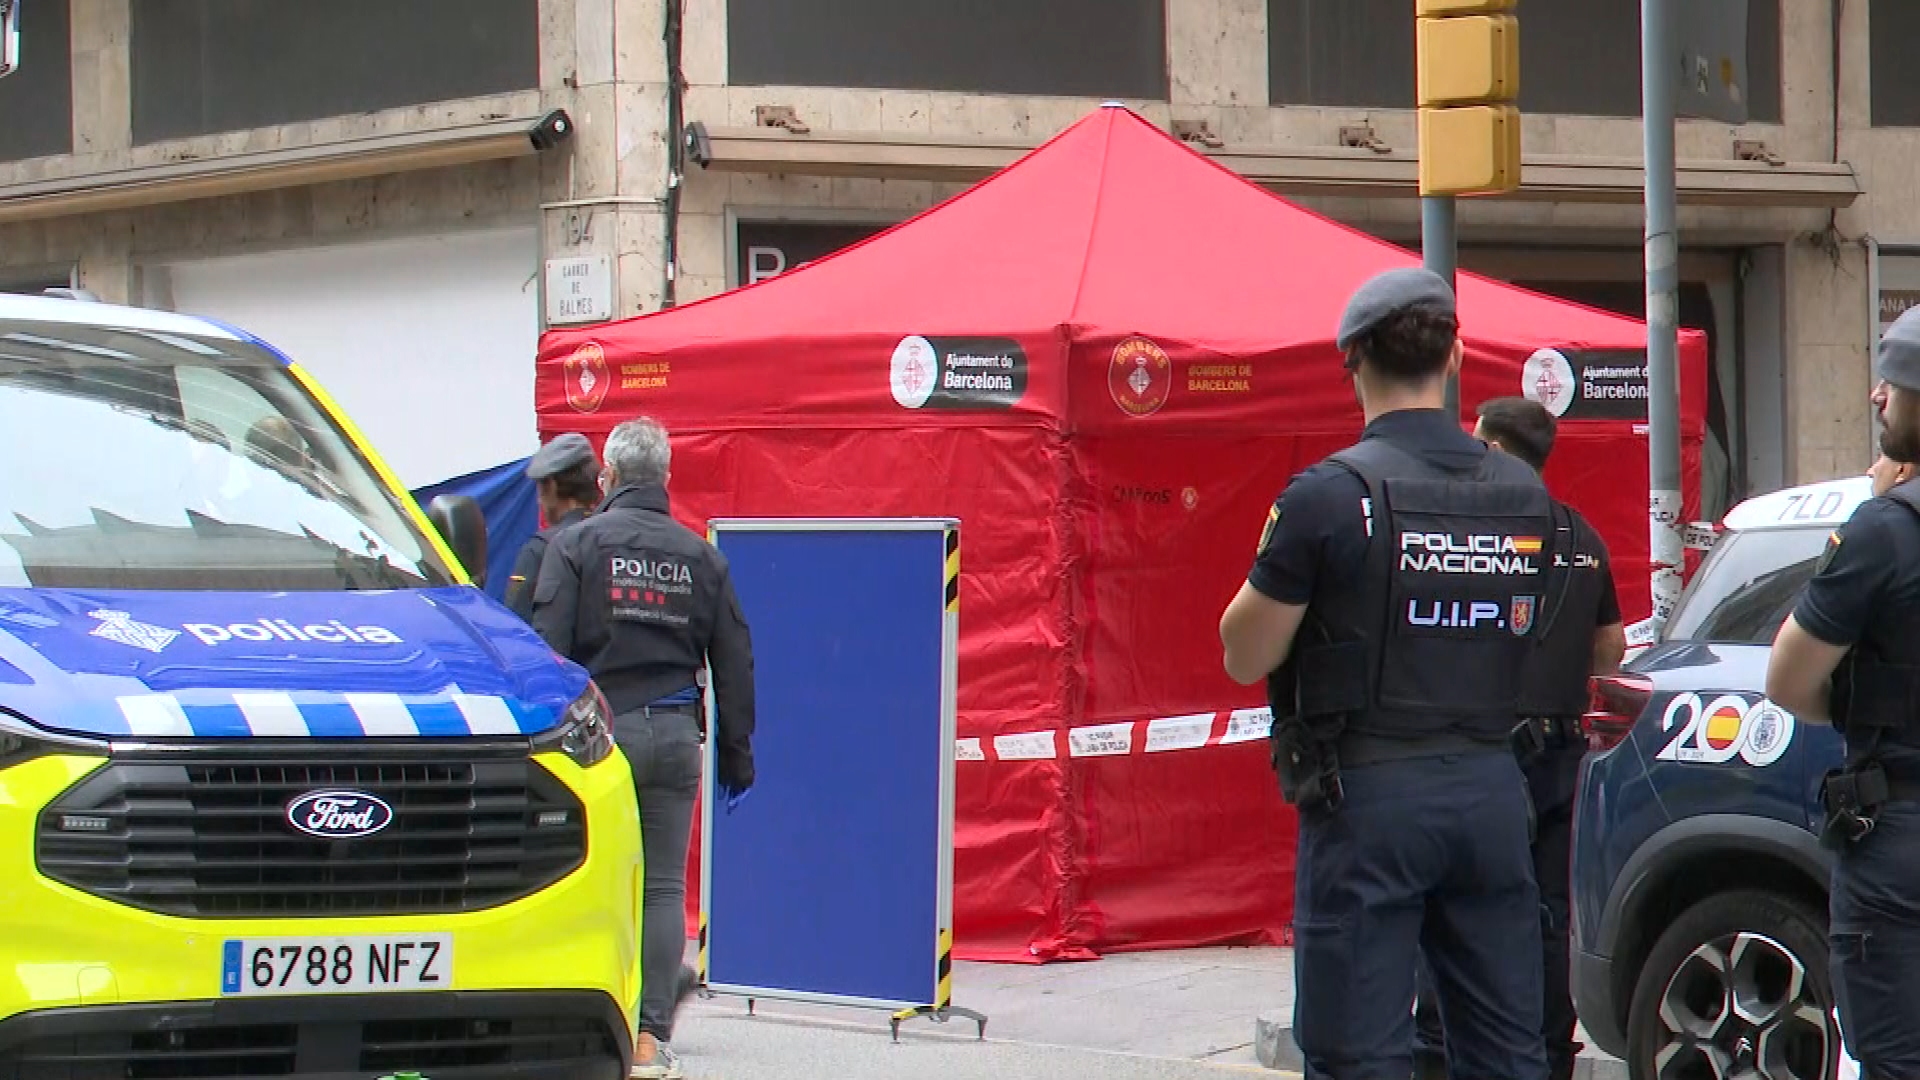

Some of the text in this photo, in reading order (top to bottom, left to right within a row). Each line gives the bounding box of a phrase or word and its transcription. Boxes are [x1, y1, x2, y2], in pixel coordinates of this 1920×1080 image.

[571, 281, 581, 294] DE
[560, 297, 593, 316] BALMES
[945, 353, 1000, 369] Ajuntament
[1188, 364, 1252, 377] BOMBERS DE
[943, 370, 1013, 390] Barcelona
[1583, 365, 1641, 381] Ajuntament
[1188, 379, 1250, 391] BARCELONA
[1777, 492, 1844, 521] 7LD
[1401, 532, 1519, 554] POLICIA
[611, 557, 692, 583] POLICIA
[1400, 554, 1539, 575] NACIONAL
[1407, 599, 1506, 629] U.I.P.
[182, 618, 405, 647] policia
[1655, 691, 1796, 767] 200
[306, 798, 375, 829] Ford
[252, 941, 441, 987] 6788 NFZ
